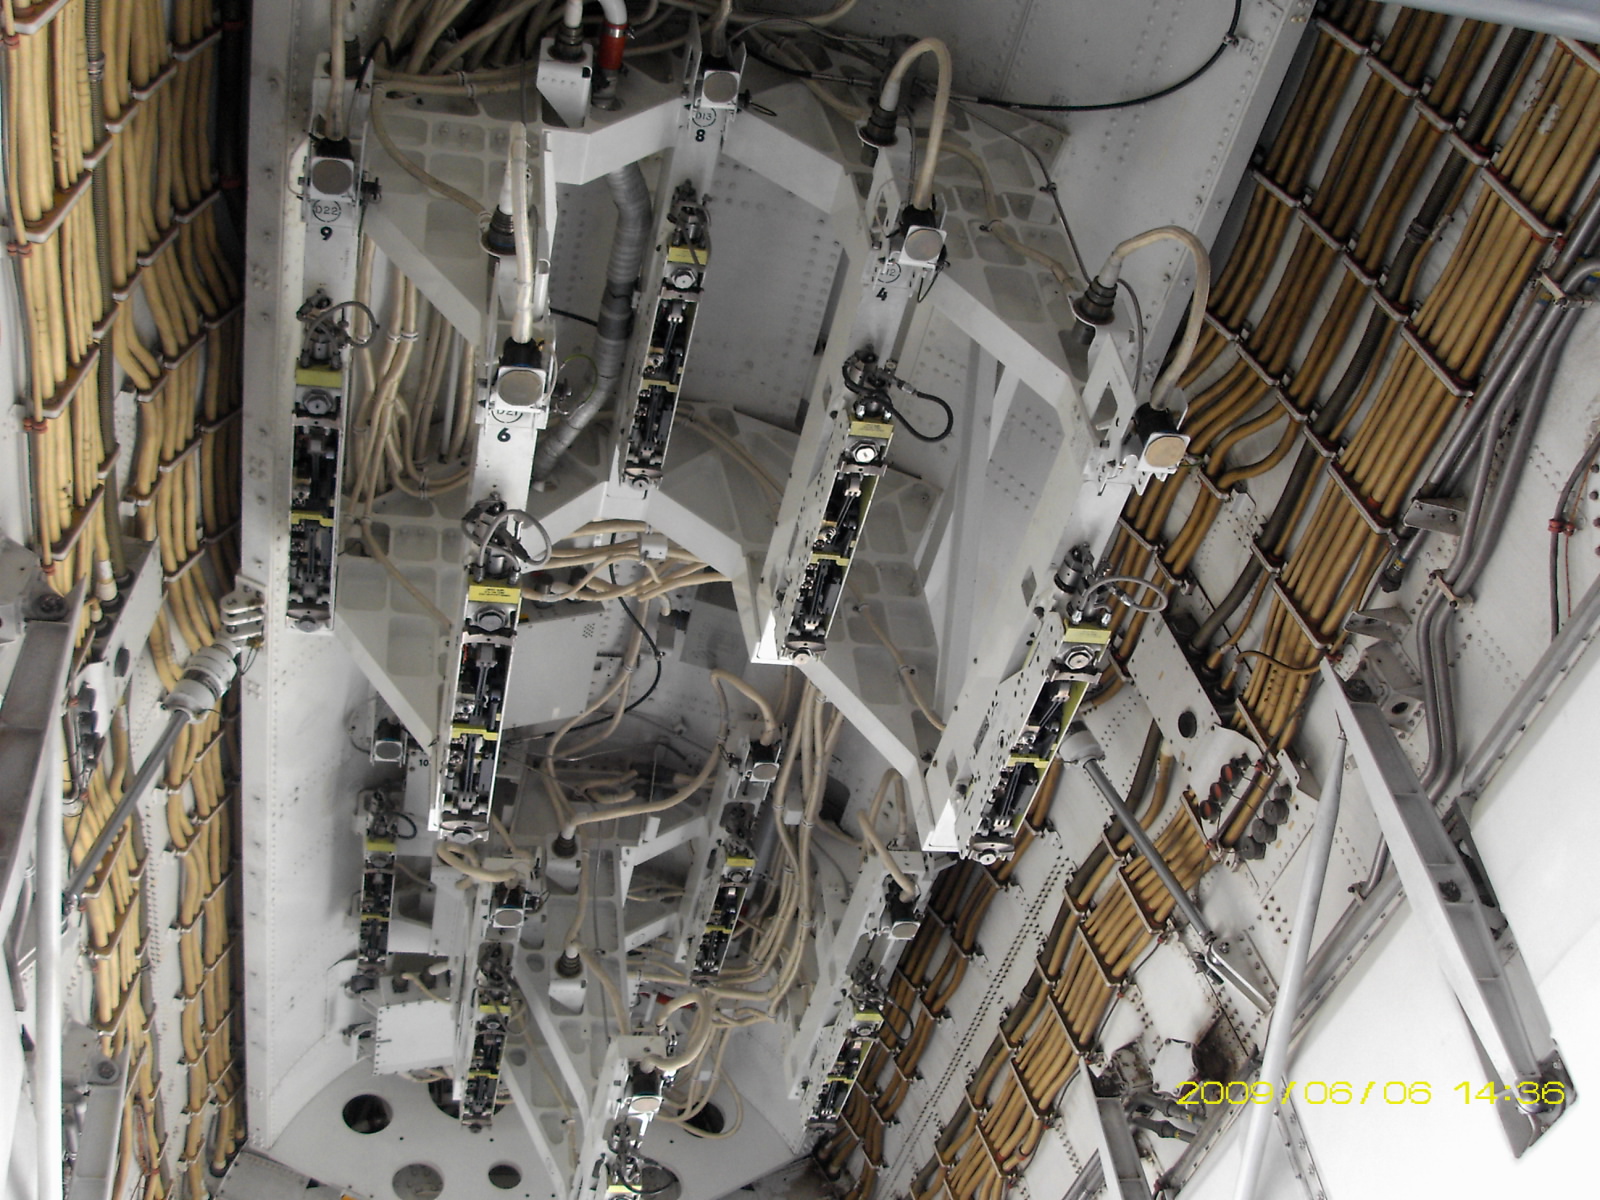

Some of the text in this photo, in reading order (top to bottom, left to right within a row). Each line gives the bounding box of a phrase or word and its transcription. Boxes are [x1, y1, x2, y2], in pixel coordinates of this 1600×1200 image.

[695, 129, 706, 142] 8
[315, 205, 338, 216] D22
[320, 226, 333, 241] 9
[876, 287, 888, 301] 4
[497, 427, 511, 443] 6
[419, 759, 429, 767] 10
